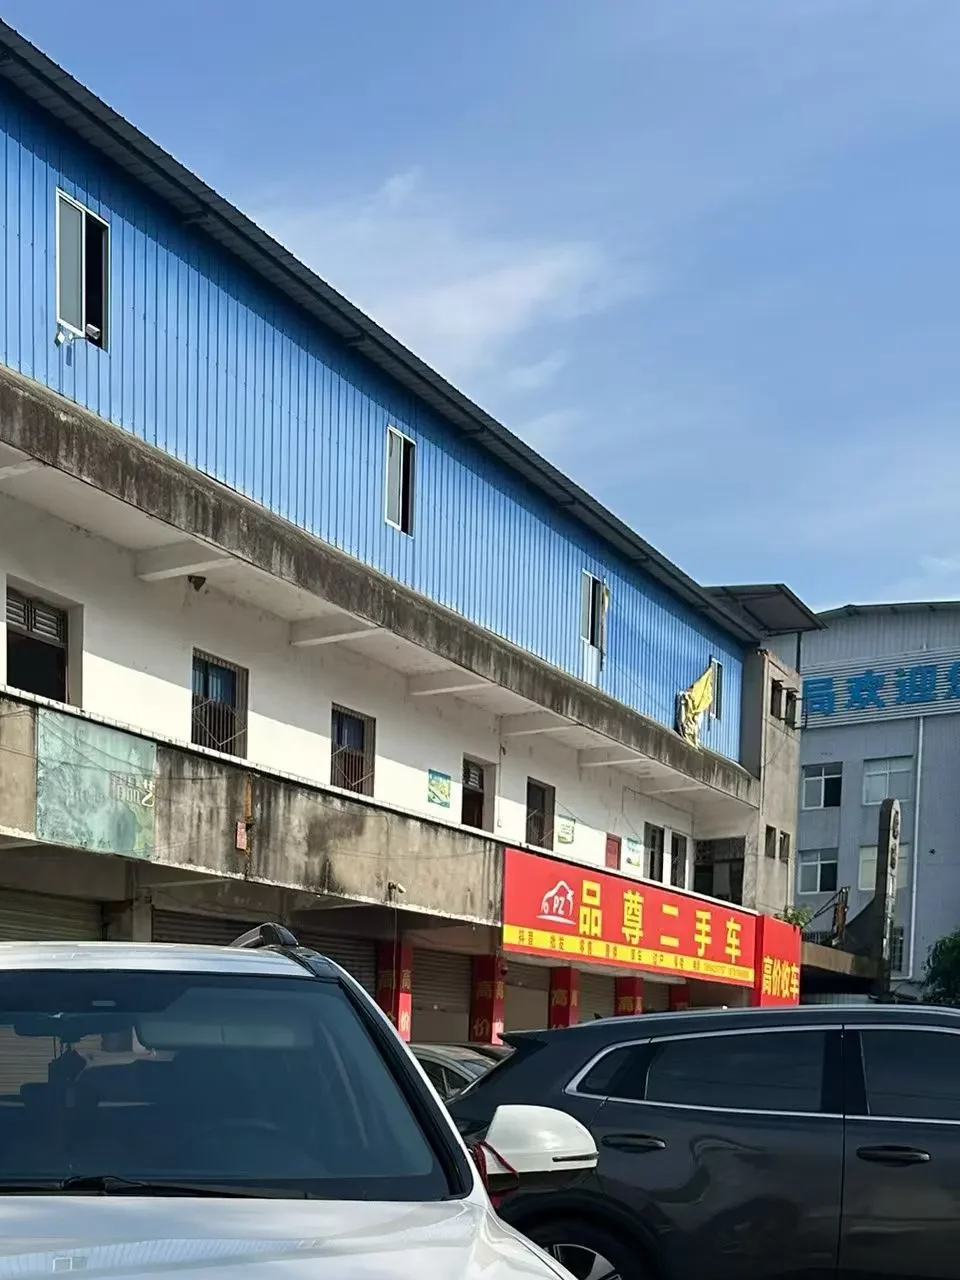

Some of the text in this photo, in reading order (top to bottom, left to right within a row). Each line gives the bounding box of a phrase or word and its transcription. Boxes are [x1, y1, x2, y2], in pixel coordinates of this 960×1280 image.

[802, 659, 960, 716] 司欢迎
[578, 879, 743, 963] 品尊二手车
